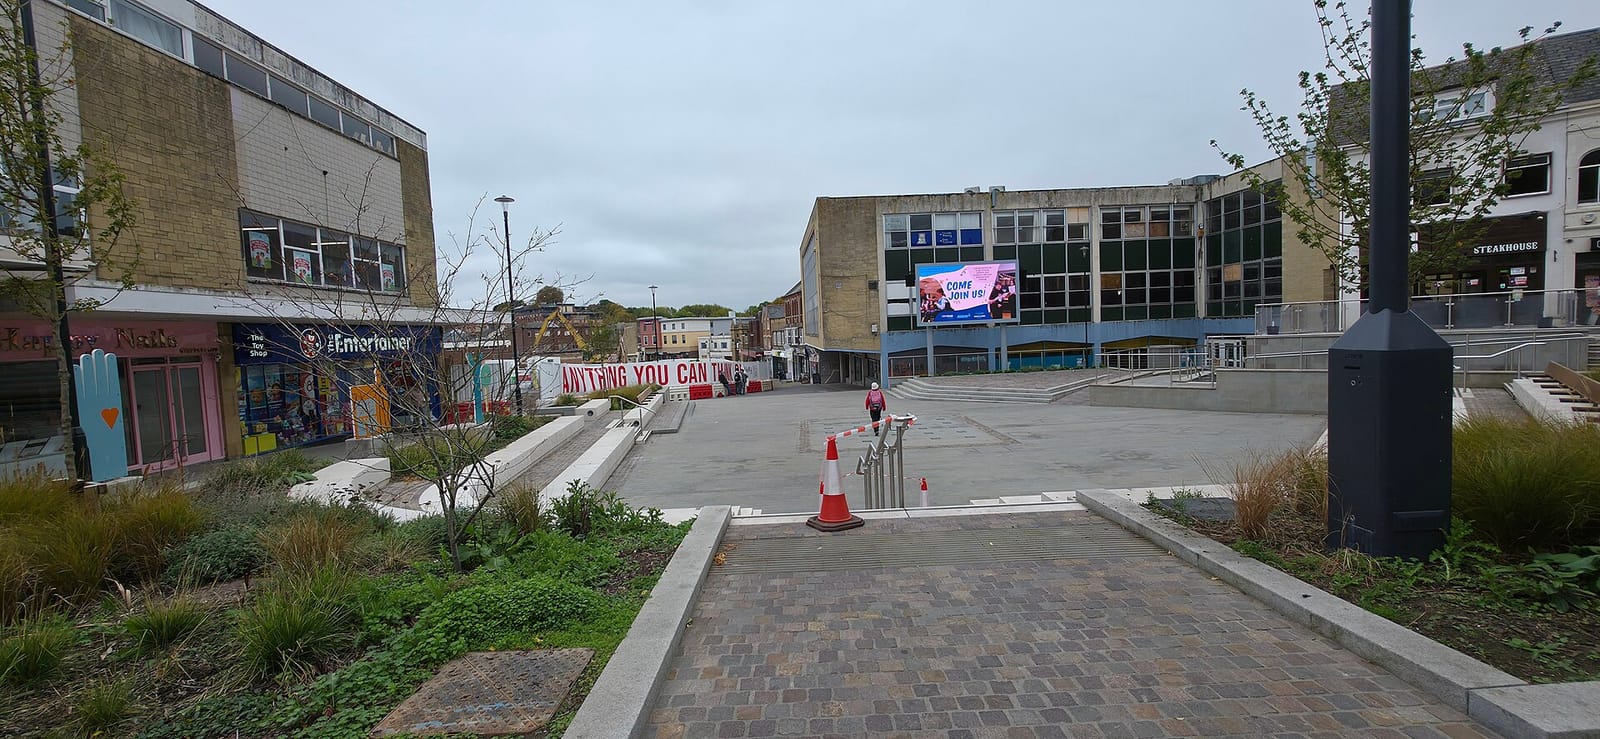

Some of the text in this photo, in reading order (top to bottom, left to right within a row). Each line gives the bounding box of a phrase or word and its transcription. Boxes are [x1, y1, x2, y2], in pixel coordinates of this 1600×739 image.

[1473, 242, 1538, 254] STEAKHOUSE
[947, 281, 972, 291] COME
[949, 290, 986, 300] JOIN US!
[114, 328, 178, 349] Nails
[335, 333, 411, 353] Entertainer
[252, 342, 264, 350] Toy
[562, 366, 627, 393] ANYTHING
[634, 364, 669, 386] YOU
[677, 363, 707, 385] CAN
